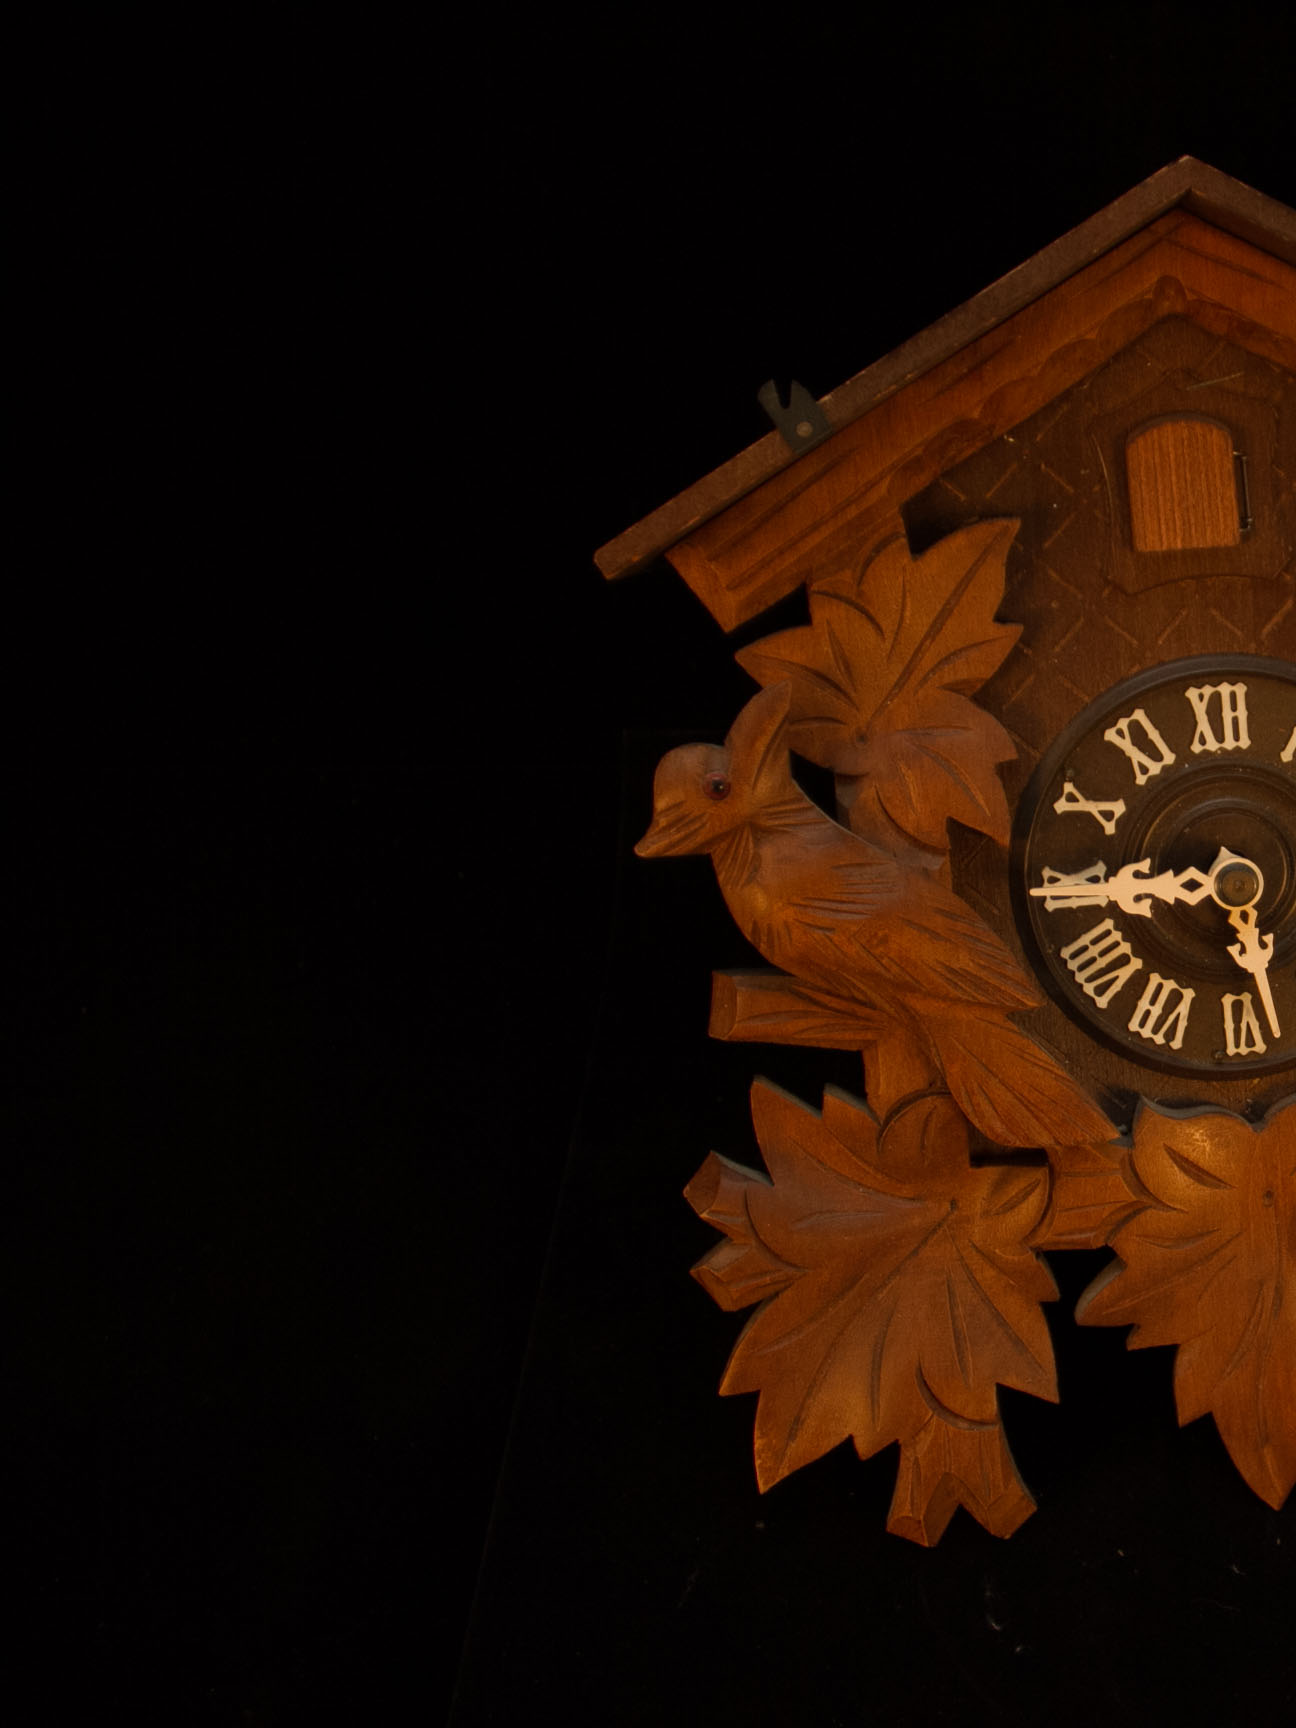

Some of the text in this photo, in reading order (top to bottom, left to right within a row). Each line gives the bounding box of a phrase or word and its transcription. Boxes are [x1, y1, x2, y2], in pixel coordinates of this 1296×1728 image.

[1103, 707, 1177, 786] XI
[1184, 681, 1252, 754] XII
[1052, 781, 1127, 836] X
[1059, 917, 1143, 1009] VIII
[1127, 972, 1197, 1050] VII
[1220, 991, 1268, 1057] VI
